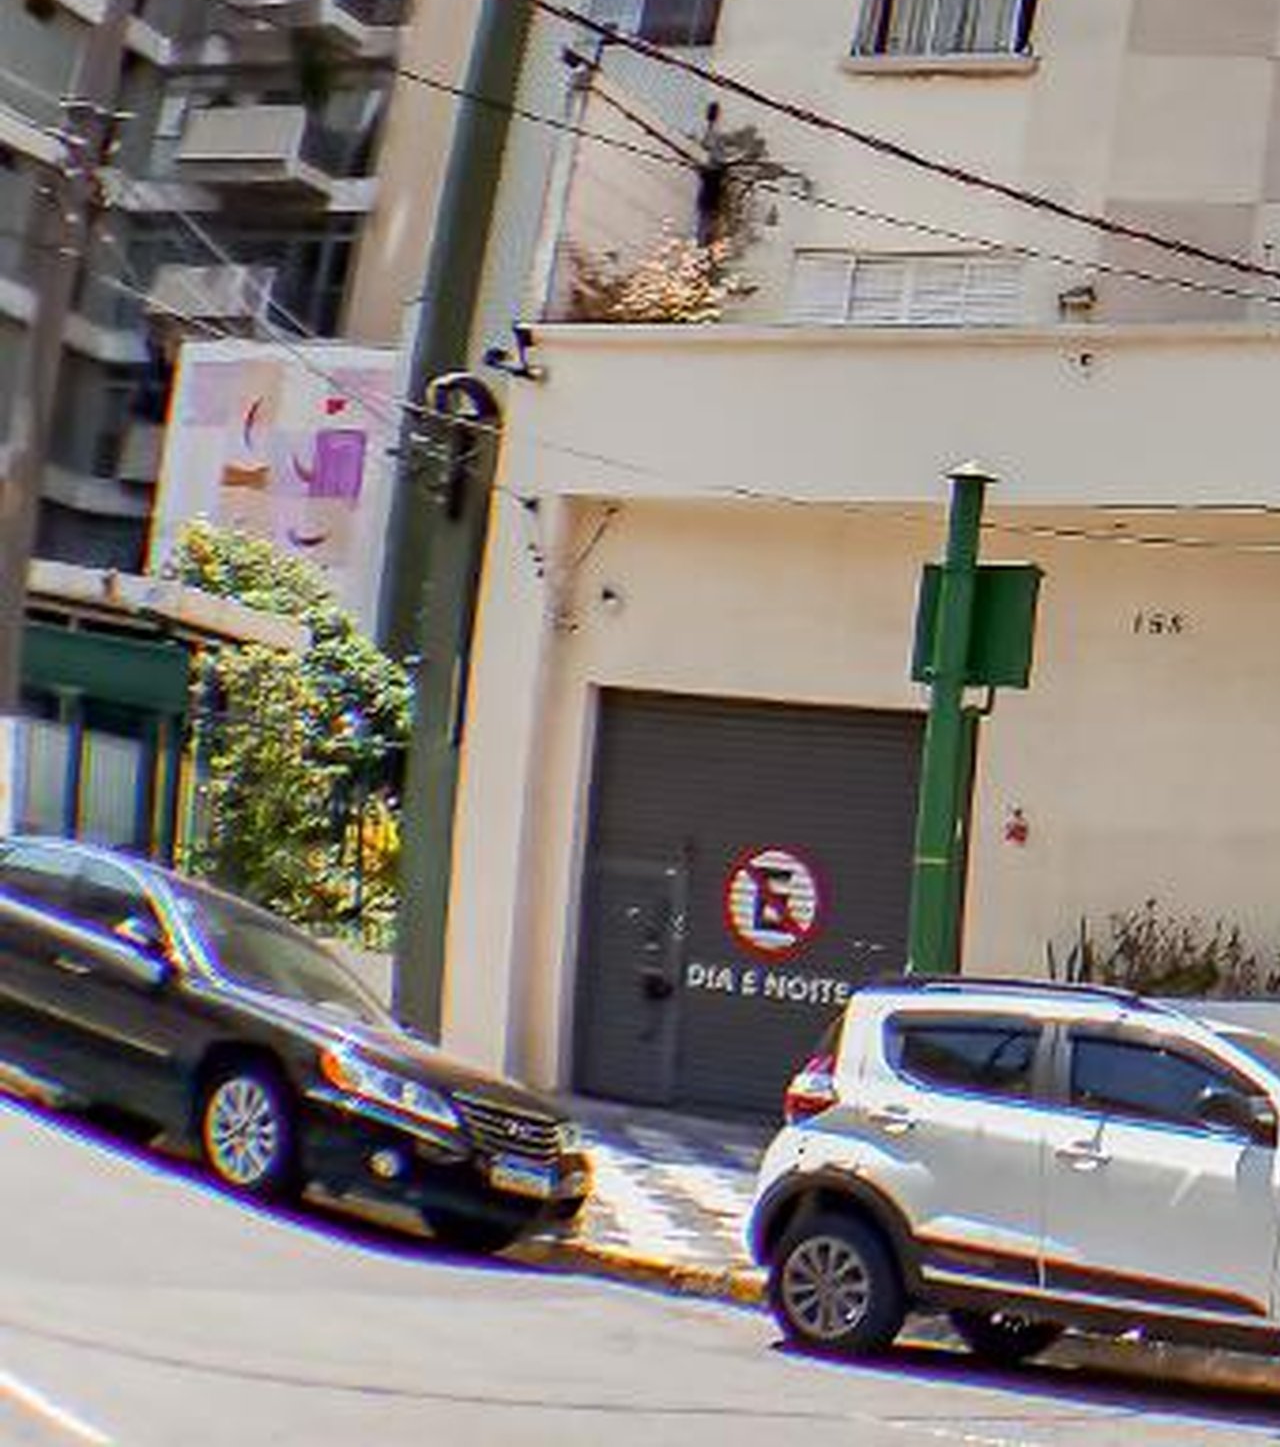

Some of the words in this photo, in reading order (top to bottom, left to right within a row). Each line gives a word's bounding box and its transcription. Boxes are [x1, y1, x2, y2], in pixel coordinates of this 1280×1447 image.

[687, 963, 734, 992] DIA
[742, 971, 758, 995] E
[764, 973, 850, 1003] NOITE
